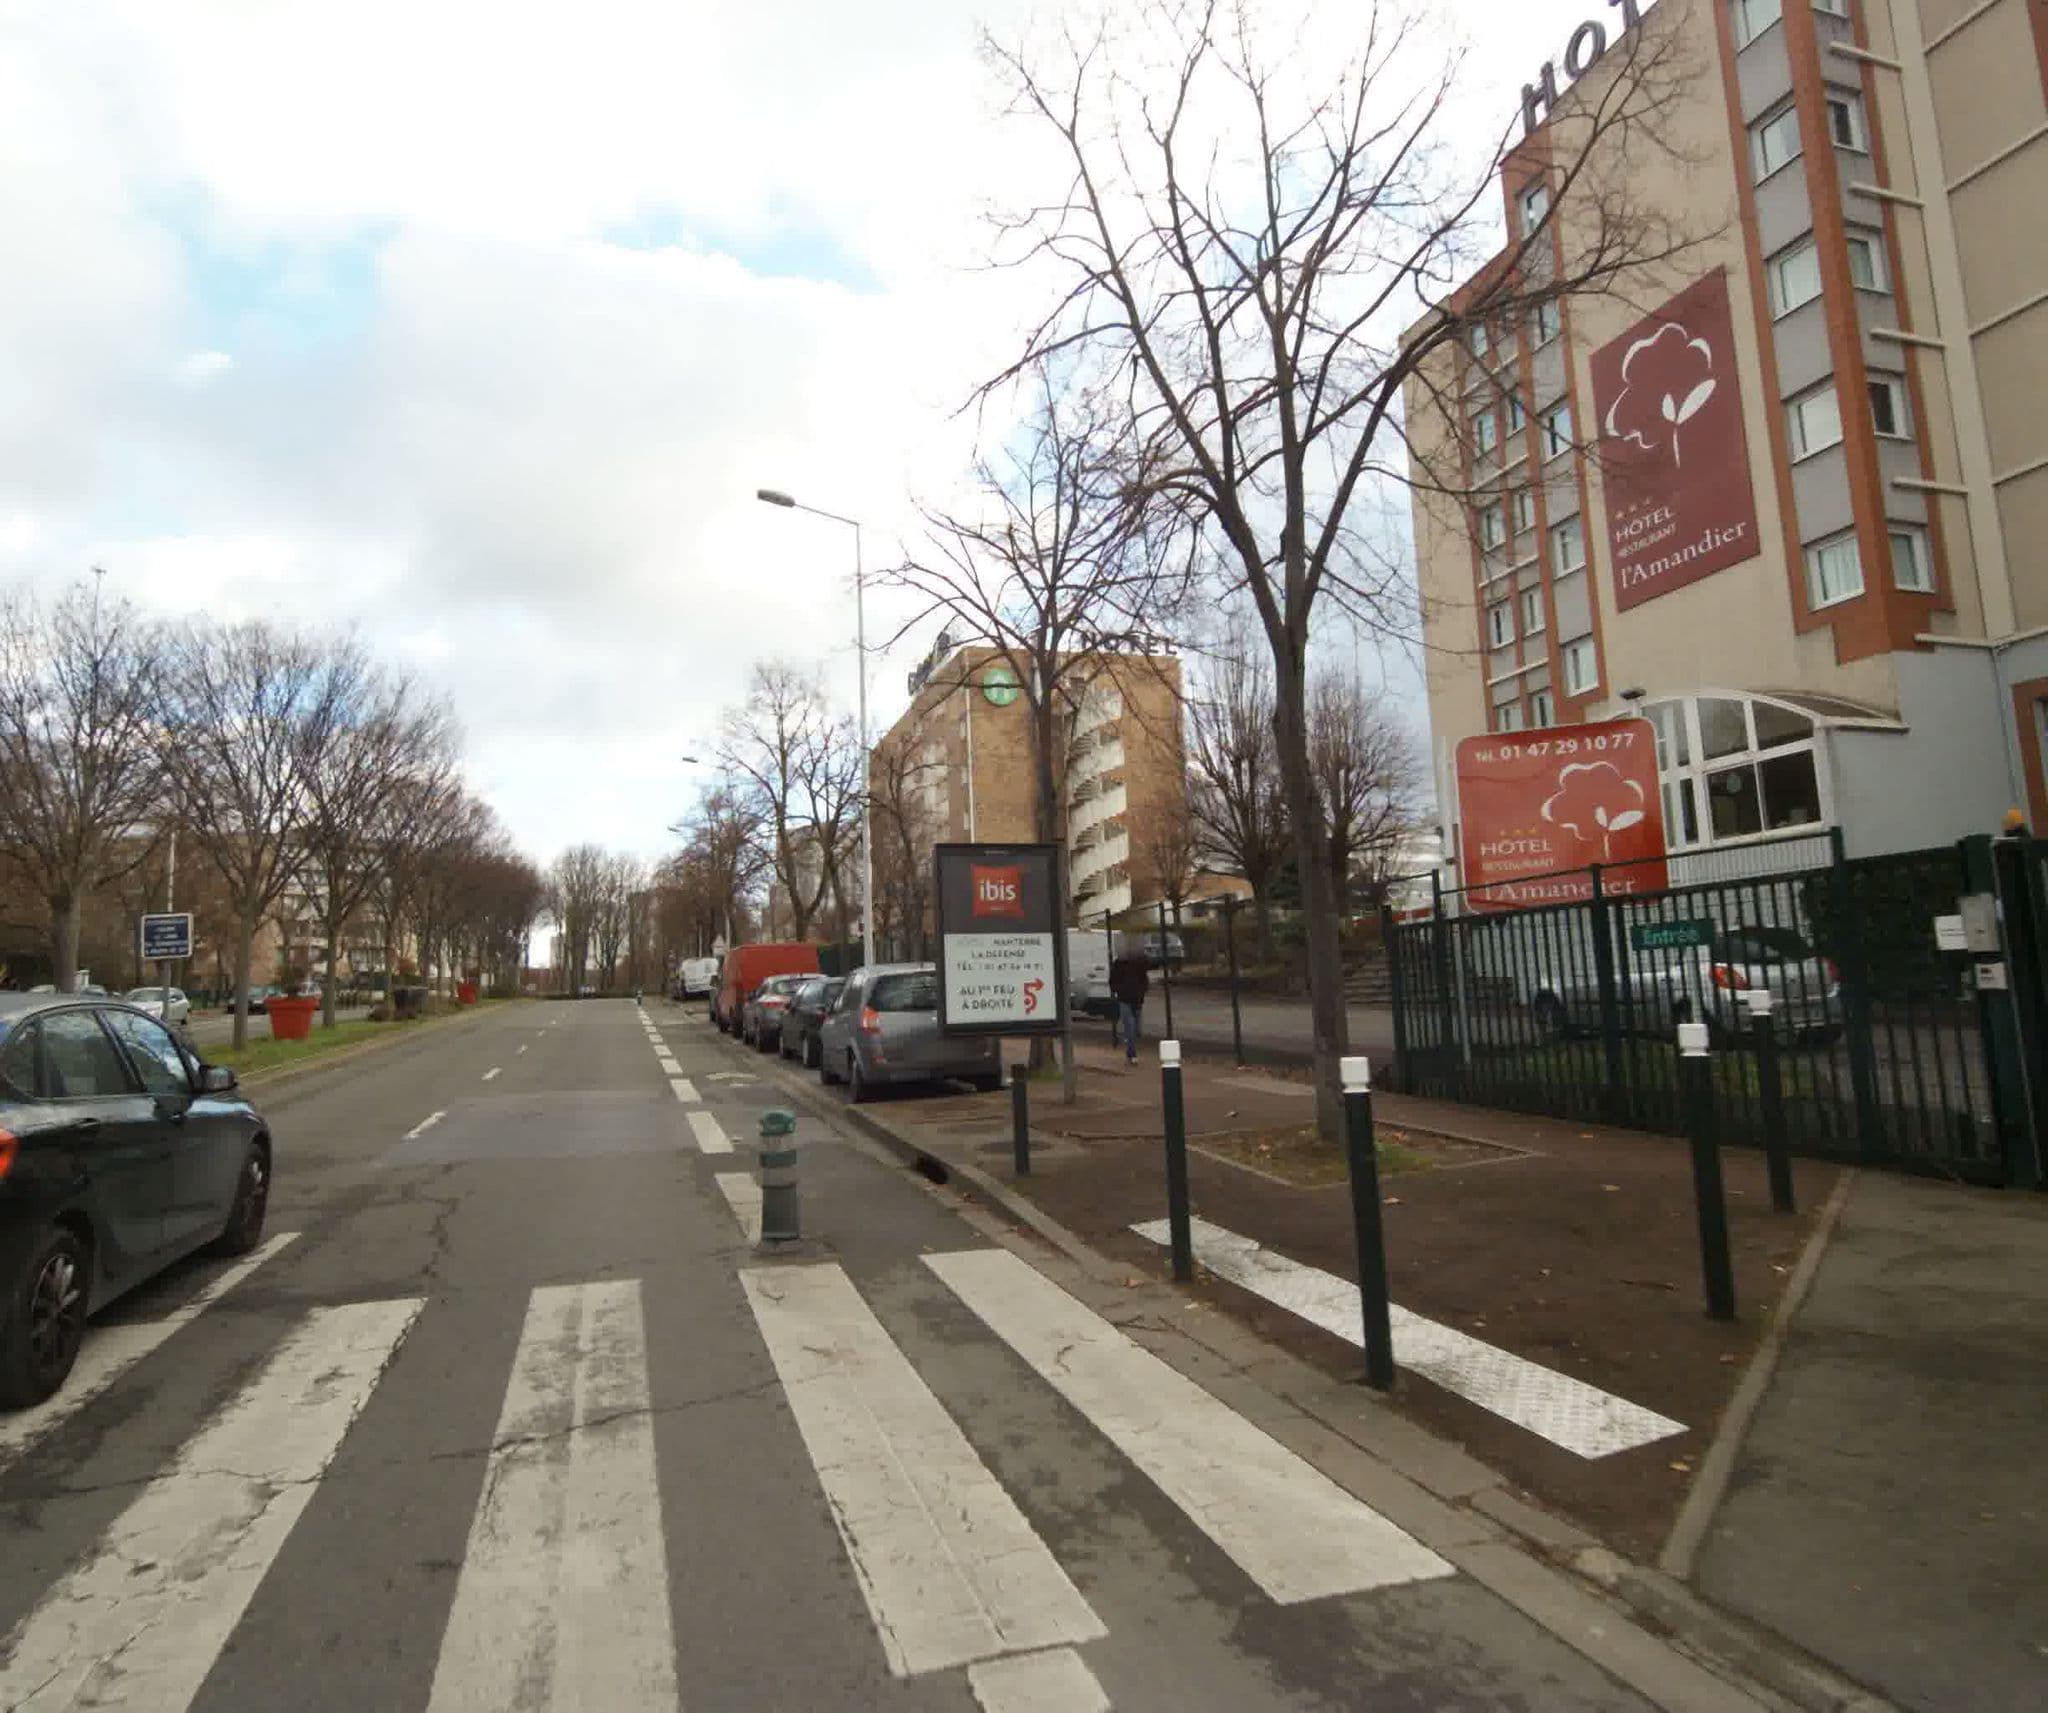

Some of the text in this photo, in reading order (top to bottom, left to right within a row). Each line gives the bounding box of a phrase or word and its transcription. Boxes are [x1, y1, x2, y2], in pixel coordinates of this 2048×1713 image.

[1621, 521, 1747, 588] l'Amandier
[1500, 745, 1520, 761] 01
[1527, 742, 1550, 758] 47
[1555, 738, 1578, 755] 29
[1584, 735, 1607, 751] 10
[1612, 732, 1635, 748] 77
[979, 879, 1017, 901] ibis
[1484, 876, 1637, 901] lAmanier
